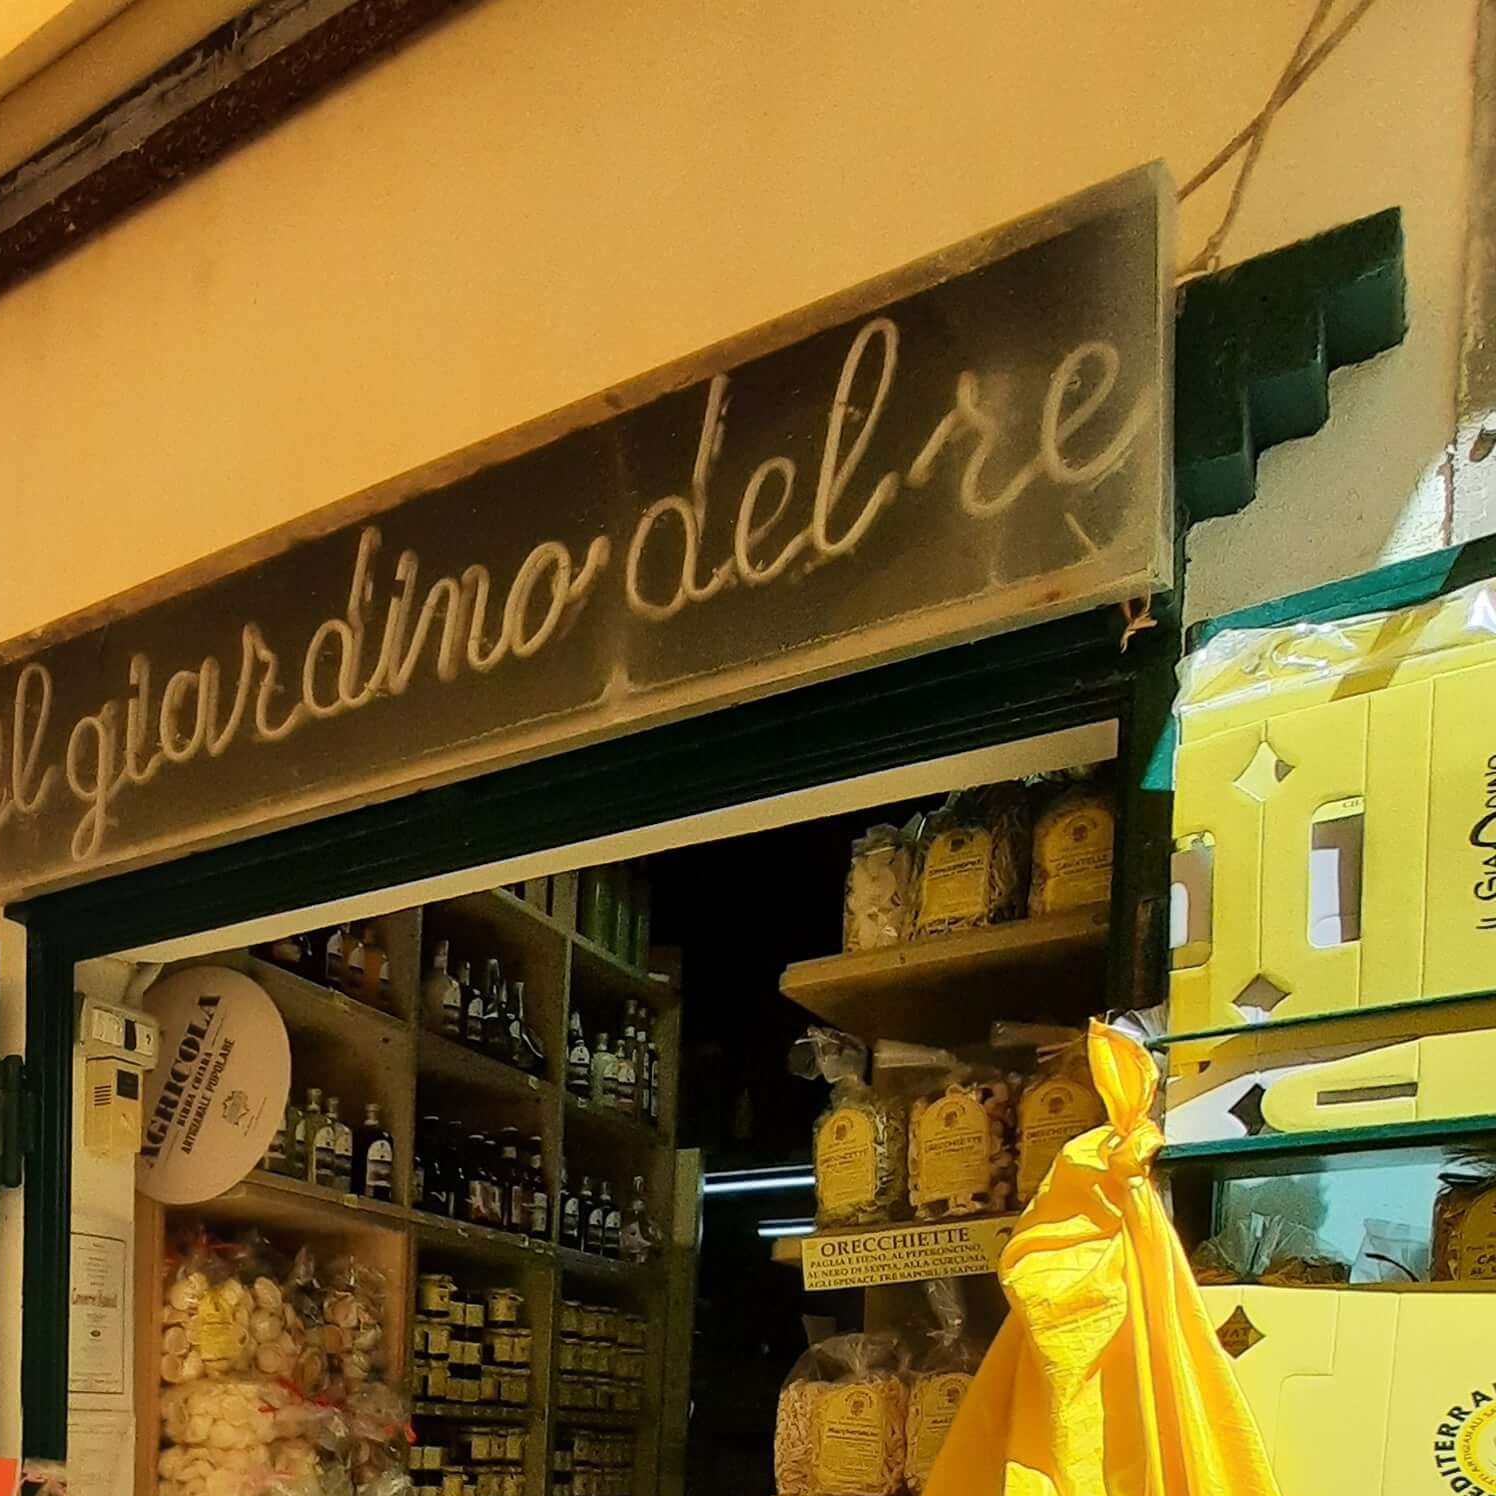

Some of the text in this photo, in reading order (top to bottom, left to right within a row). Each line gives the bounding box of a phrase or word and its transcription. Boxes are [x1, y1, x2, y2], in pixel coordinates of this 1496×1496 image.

[66, 526, 610, 863] giardino
[627, 317, 899, 621] del
[907, 342, 1154, 518] re
[820, 1227, 970, 1257] ORECCHIETTE
